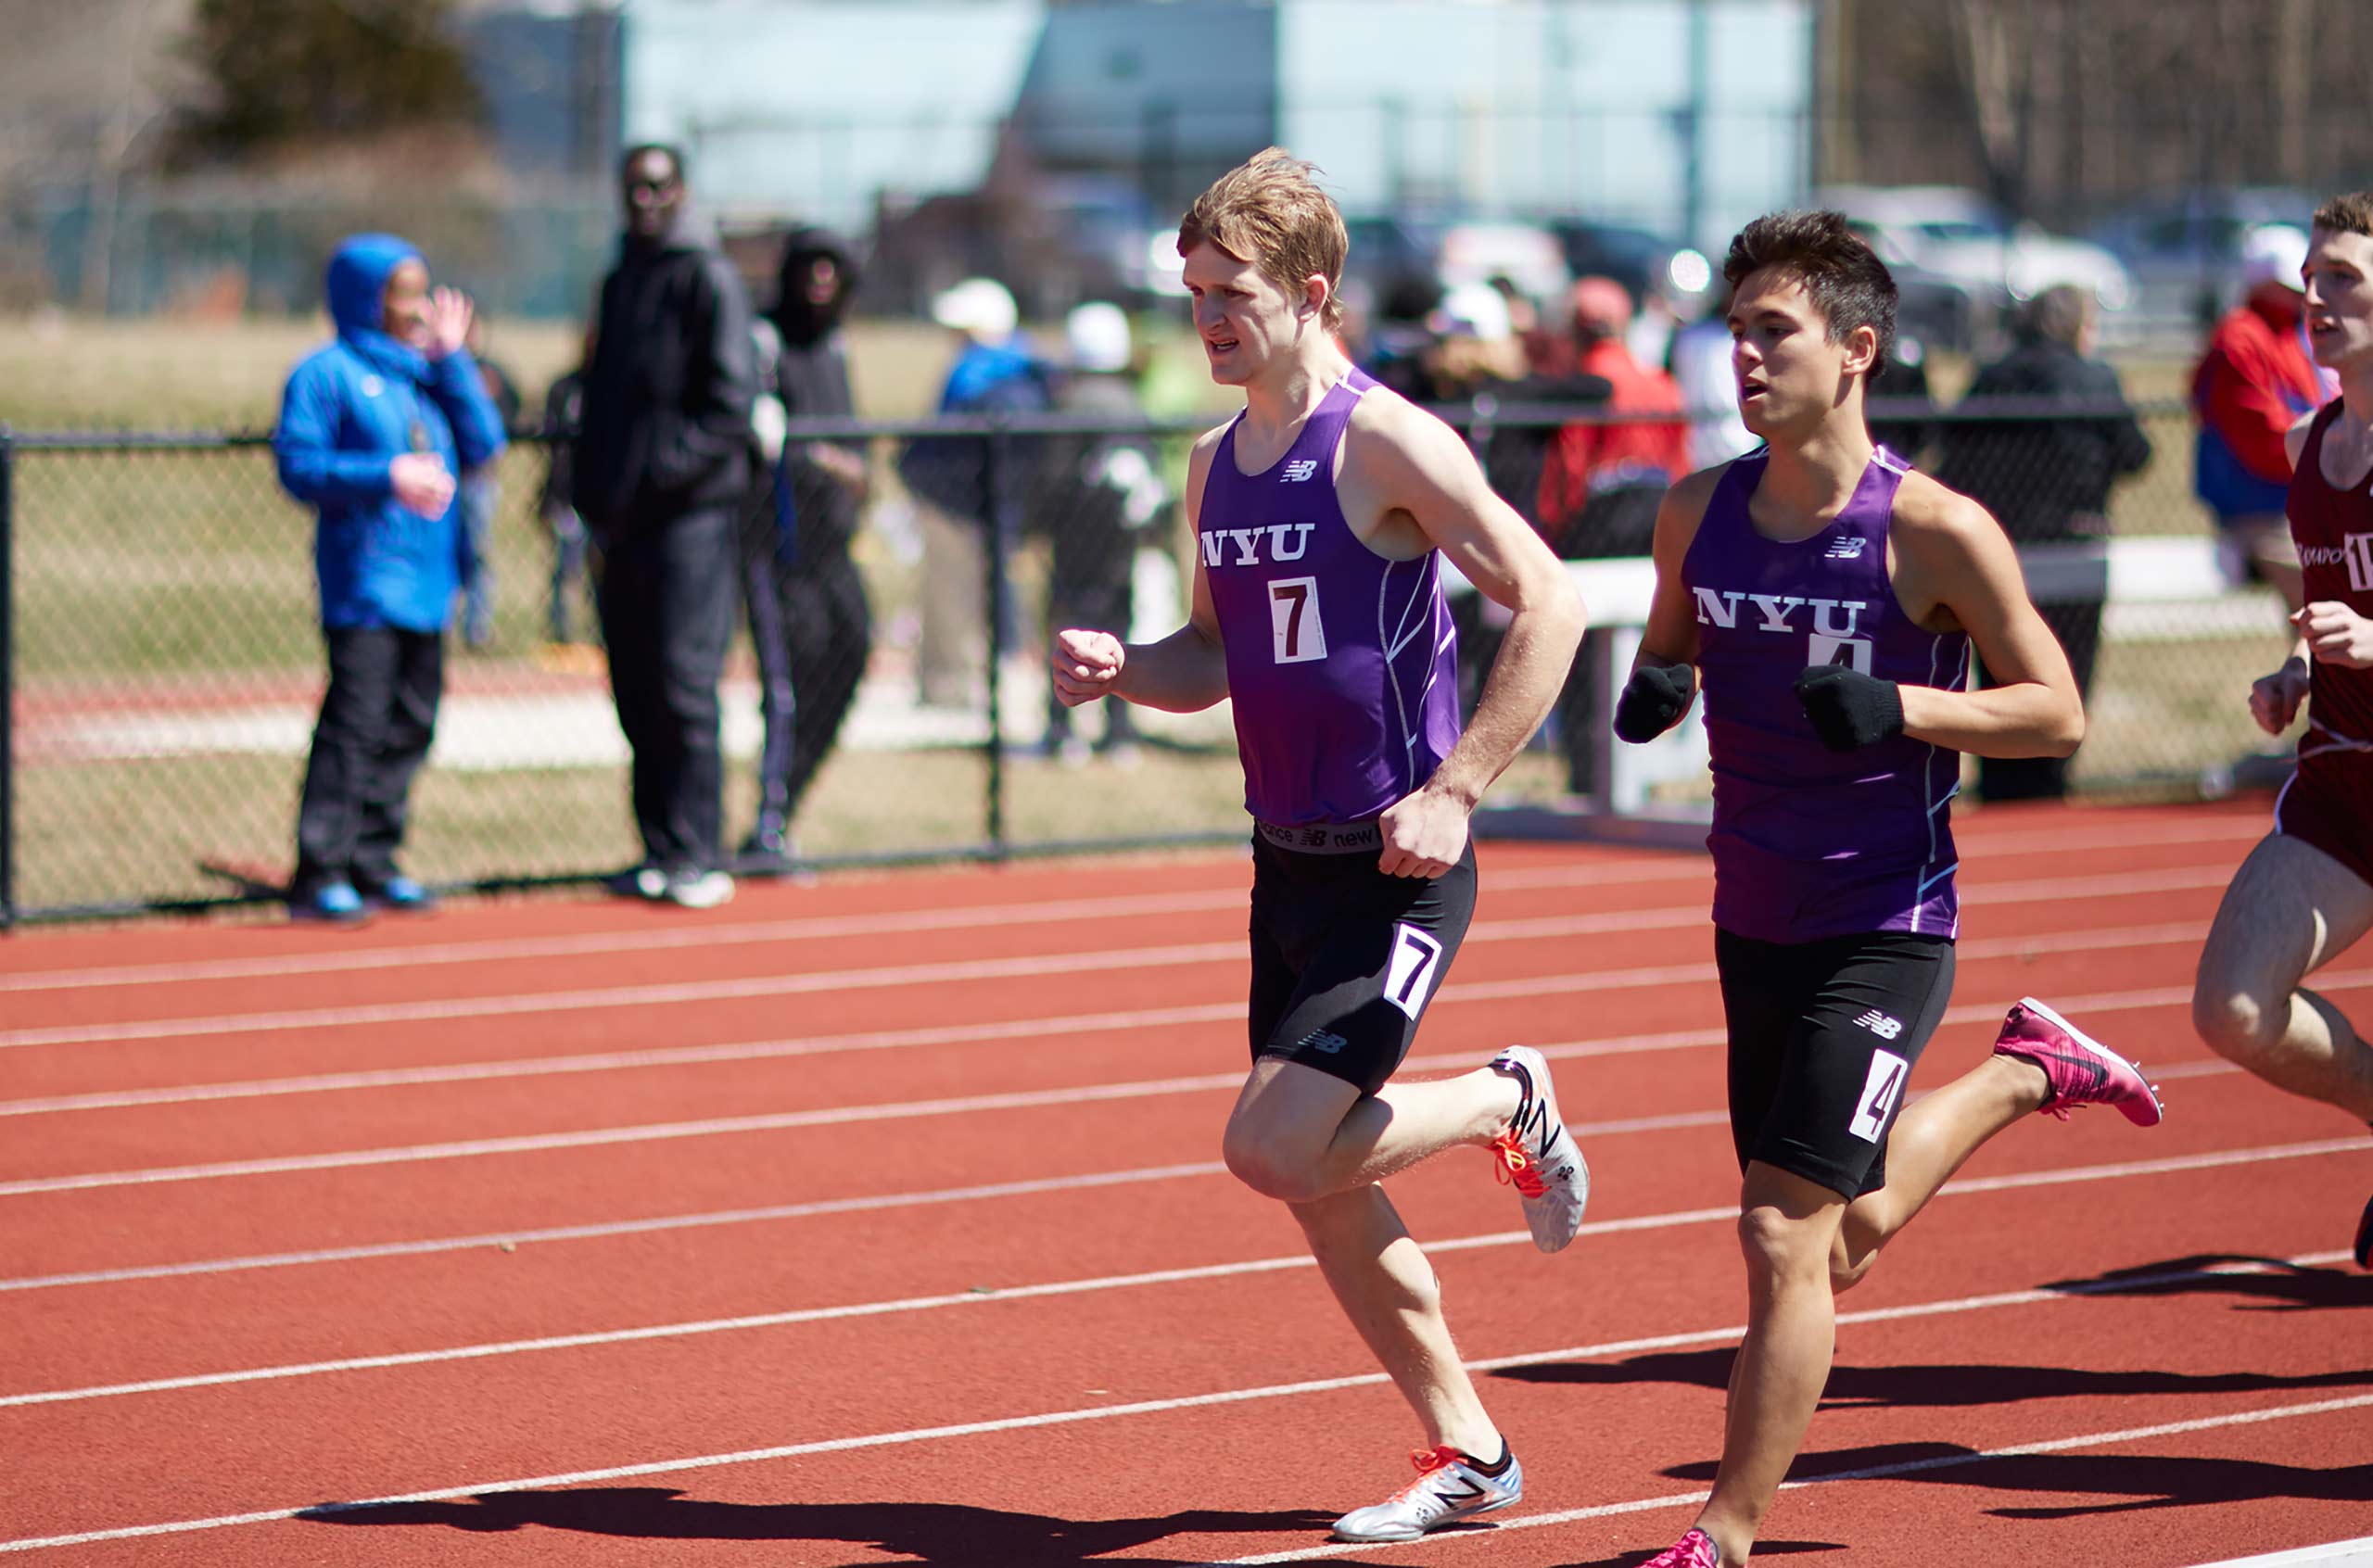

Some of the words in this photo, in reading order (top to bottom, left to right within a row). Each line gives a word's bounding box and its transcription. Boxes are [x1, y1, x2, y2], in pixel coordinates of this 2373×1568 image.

[1201, 523, 1315, 567] NYU
[1273, 584, 1308, 657] 7
[1693, 587, 1867, 638] NYU
[1334, 828, 1373, 847] new
[1397, 932, 1435, 1005] 7
[1866, 1064, 1902, 1135] 4
